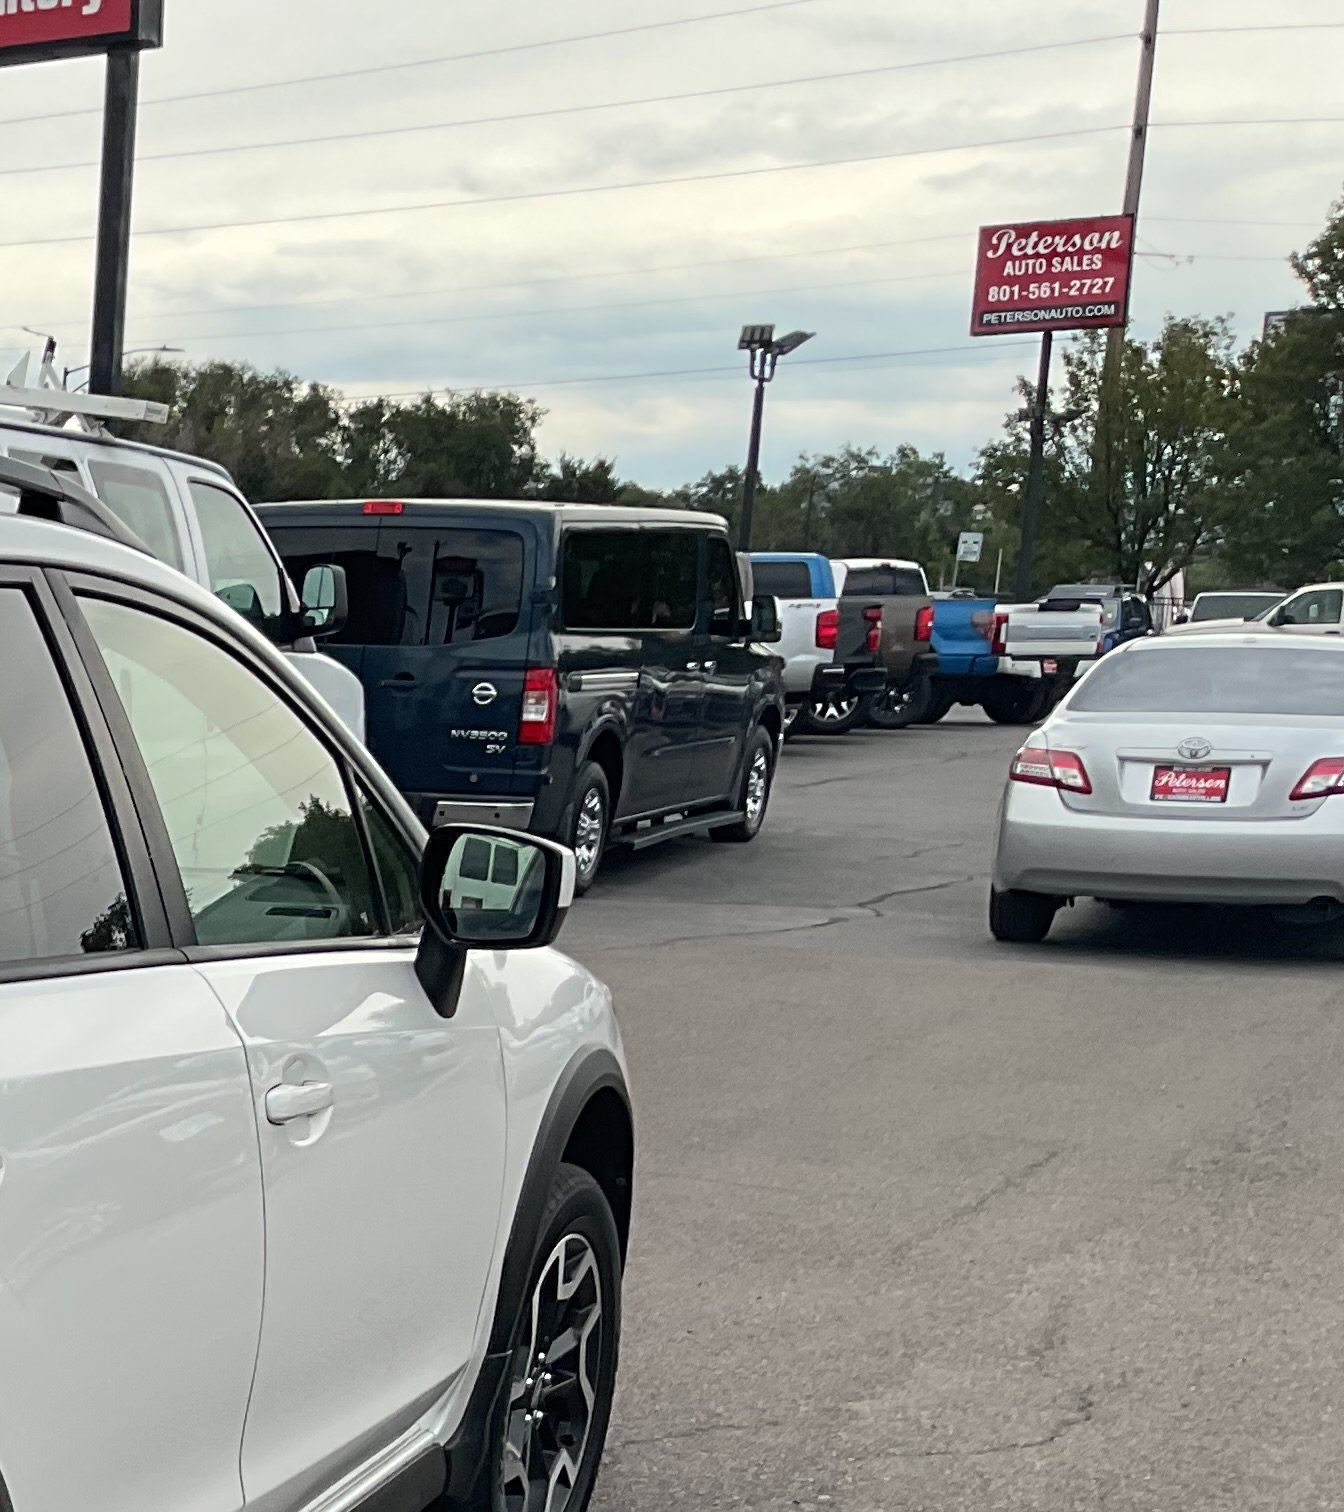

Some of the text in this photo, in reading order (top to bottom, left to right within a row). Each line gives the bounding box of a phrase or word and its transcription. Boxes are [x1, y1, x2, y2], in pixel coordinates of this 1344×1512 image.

[986, 228, 1123, 259] Peterson
[1003, 254, 1103, 277] AUTO SALES
[988, 277, 1115, 303] 801-561-2727
[982, 304, 1115, 324] PETERSONAUTO.COM
[451, 729, 508, 740] NV3500
[485, 744, 506, 753] SV
[1155, 770, 1226, 789] Peterson
